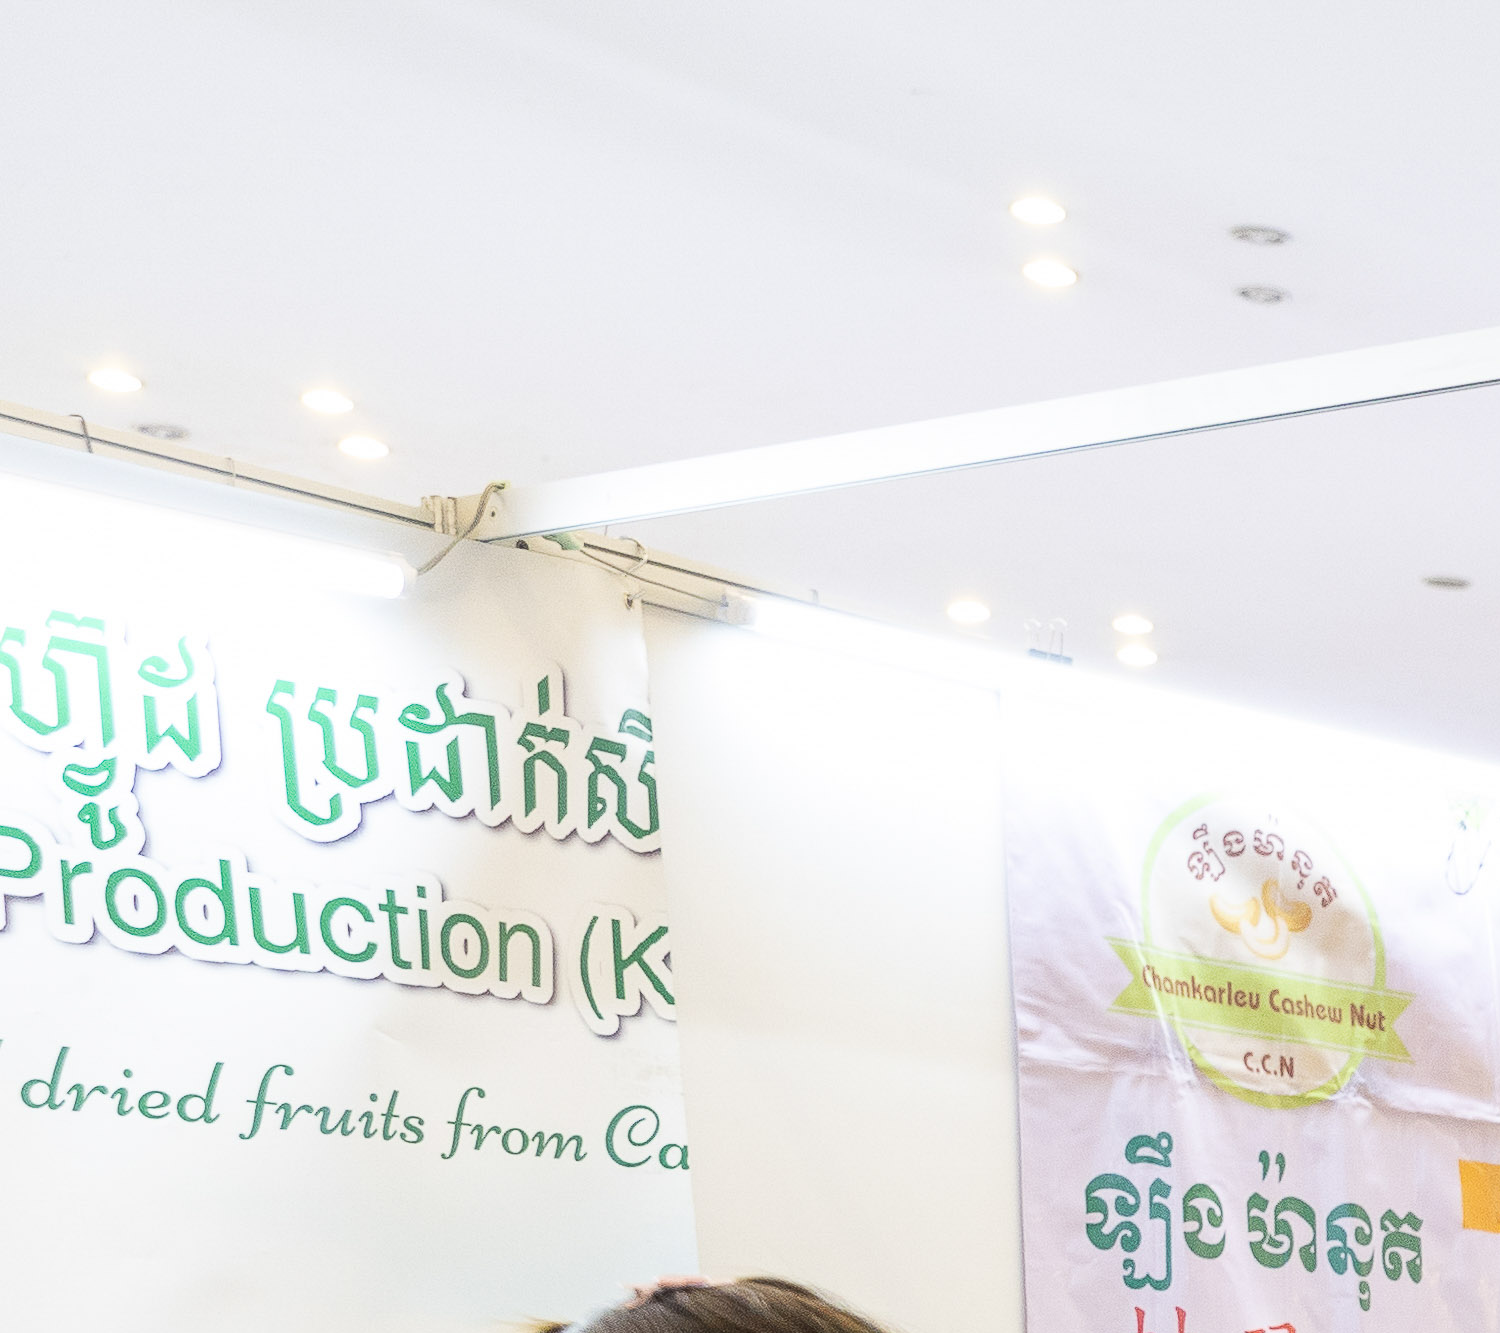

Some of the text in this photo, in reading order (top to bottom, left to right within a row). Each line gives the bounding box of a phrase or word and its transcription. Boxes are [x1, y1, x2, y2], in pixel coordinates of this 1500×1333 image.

[1142, 964, 1387, 1032] Chamkarleu Cashew Nut
[1243, 1052, 1295, 1078] C.C.N
[21, 1047, 222, 1125] dried
[240, 1064, 426, 1144] fruits
[441, 1088, 587, 1162] from
